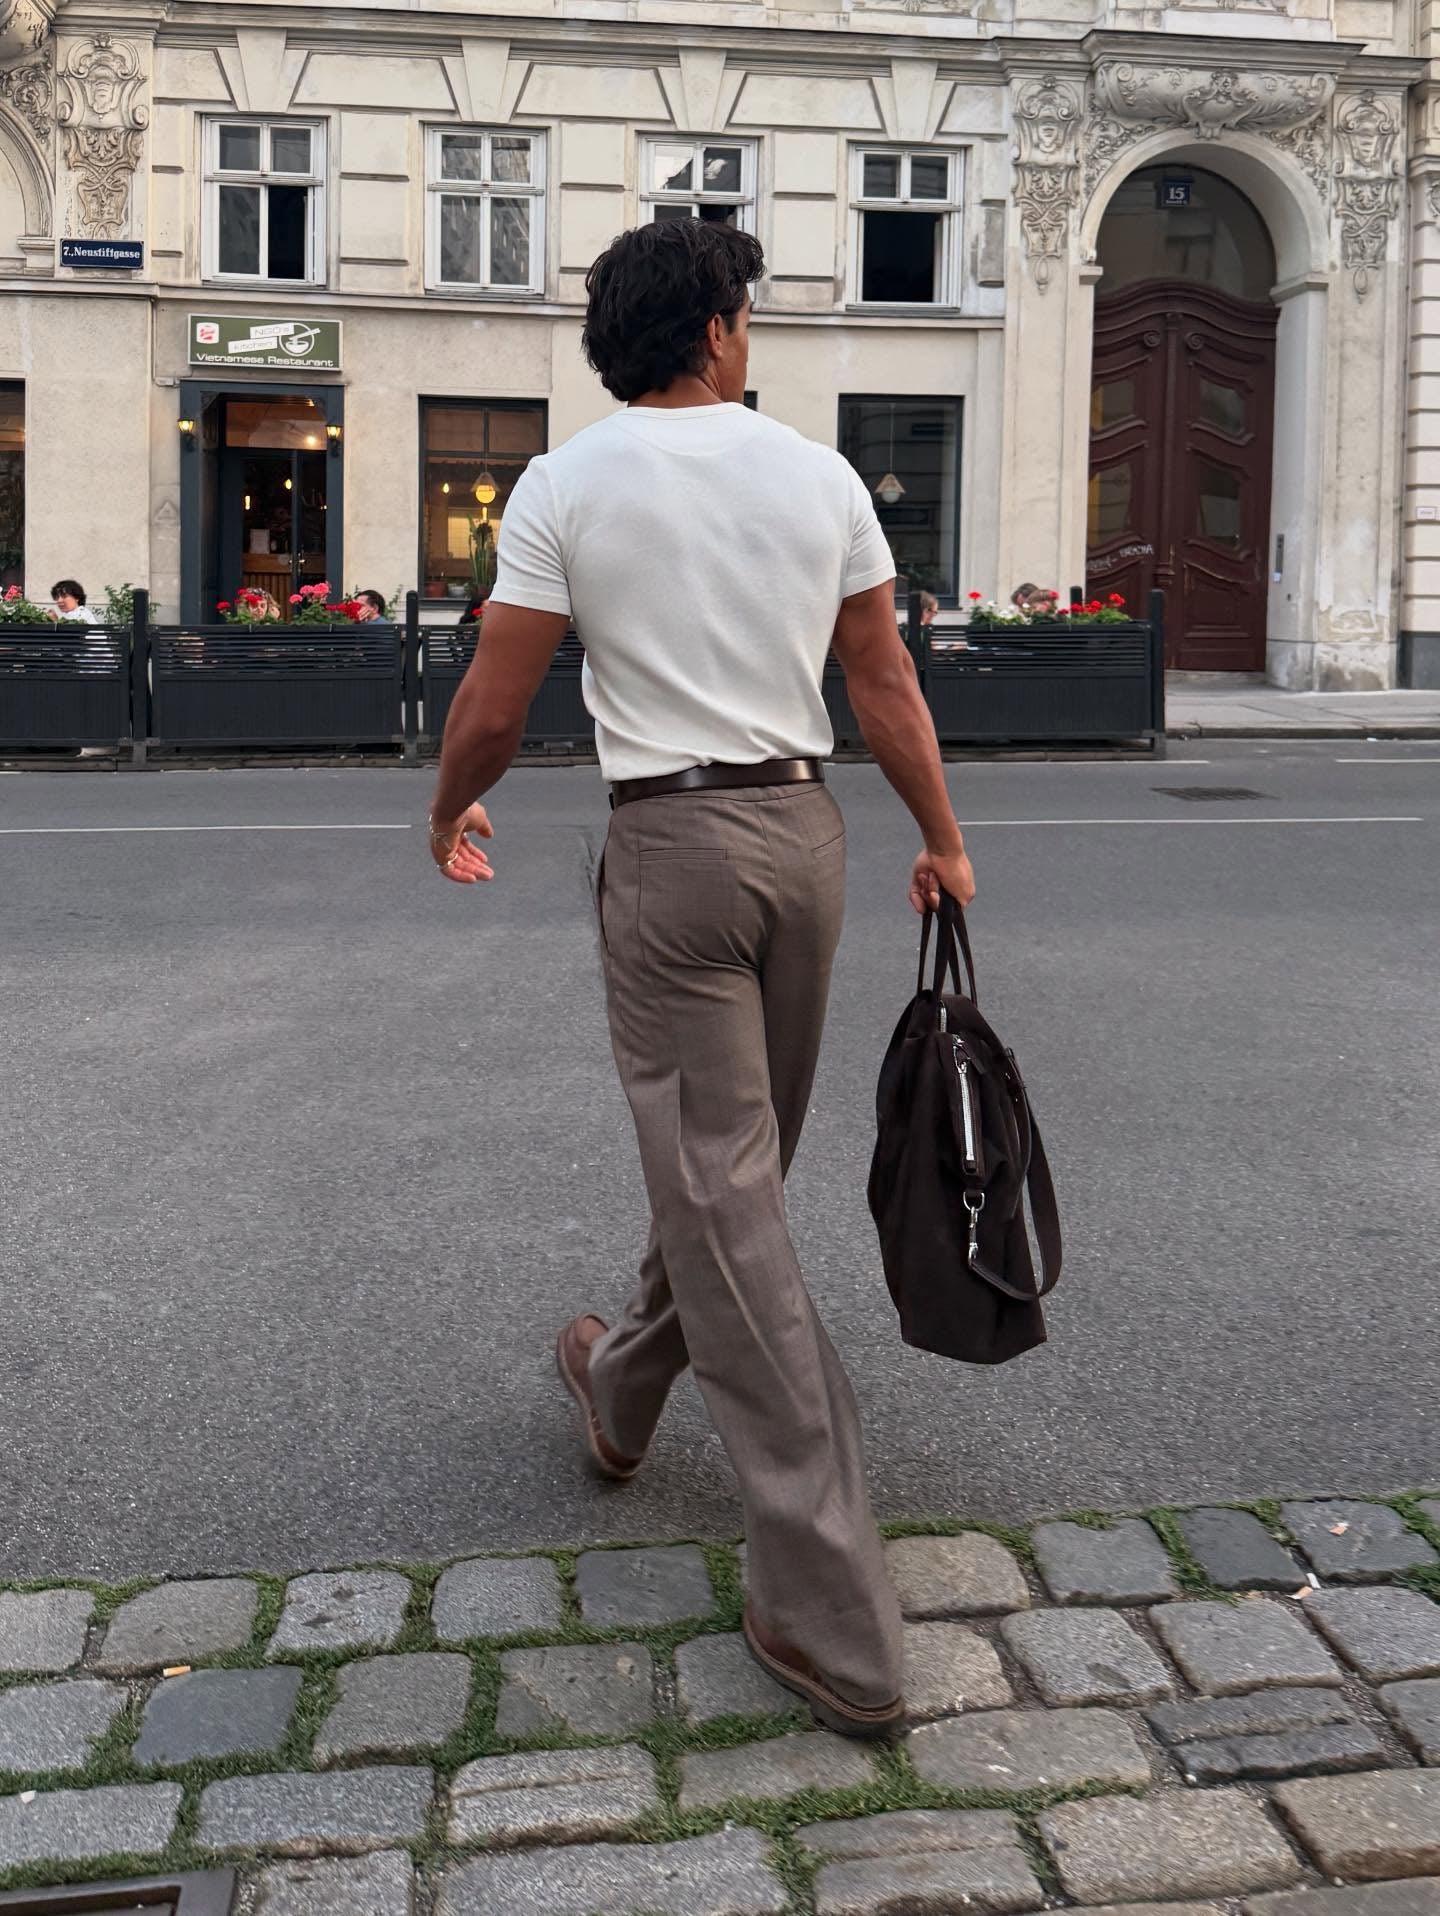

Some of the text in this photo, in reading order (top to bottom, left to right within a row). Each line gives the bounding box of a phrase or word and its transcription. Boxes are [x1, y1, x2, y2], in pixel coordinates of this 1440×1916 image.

[1169, 187, 1185, 200] 15
[196, 353, 334, 367] Vietnamese Restaurant
